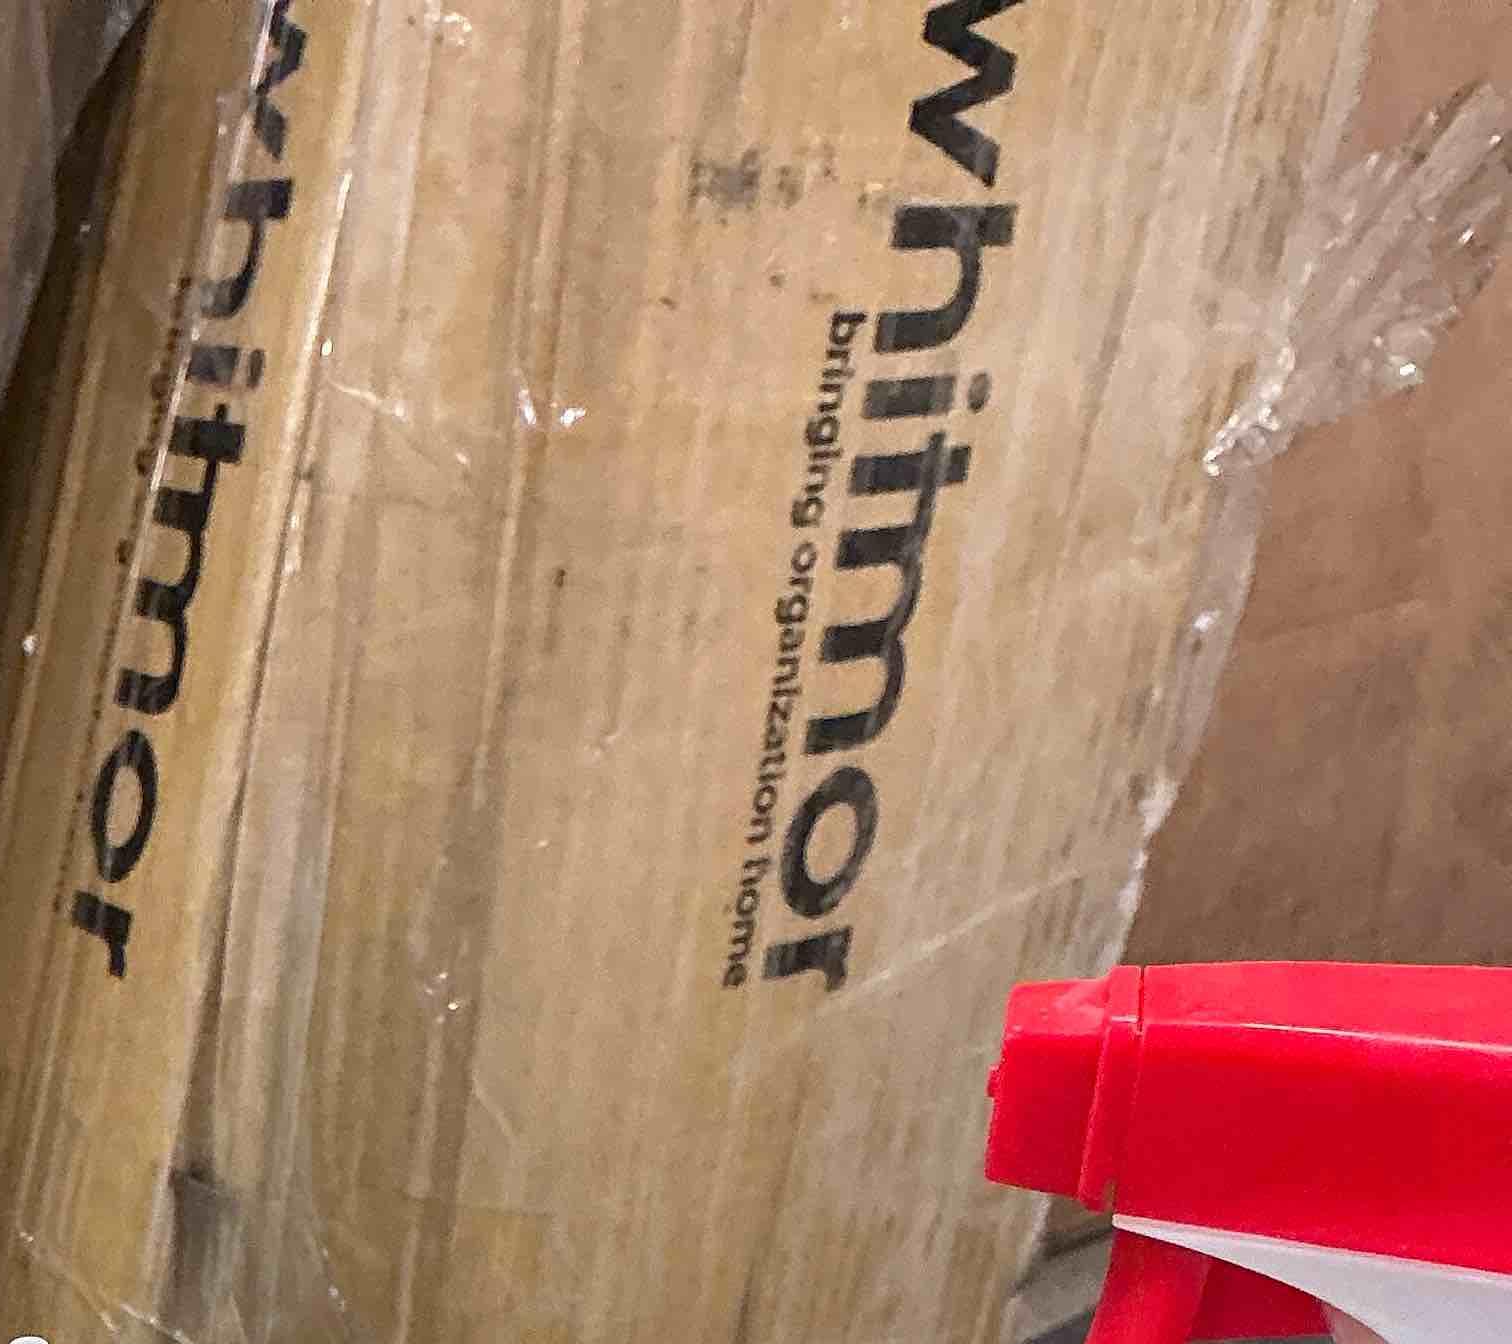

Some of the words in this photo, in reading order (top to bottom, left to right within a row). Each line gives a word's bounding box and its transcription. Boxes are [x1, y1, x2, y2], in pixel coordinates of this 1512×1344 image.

[792, 310, 867, 529] bringing
[745, 540, 819, 845] organization
[721, 858, 771, 991] home
